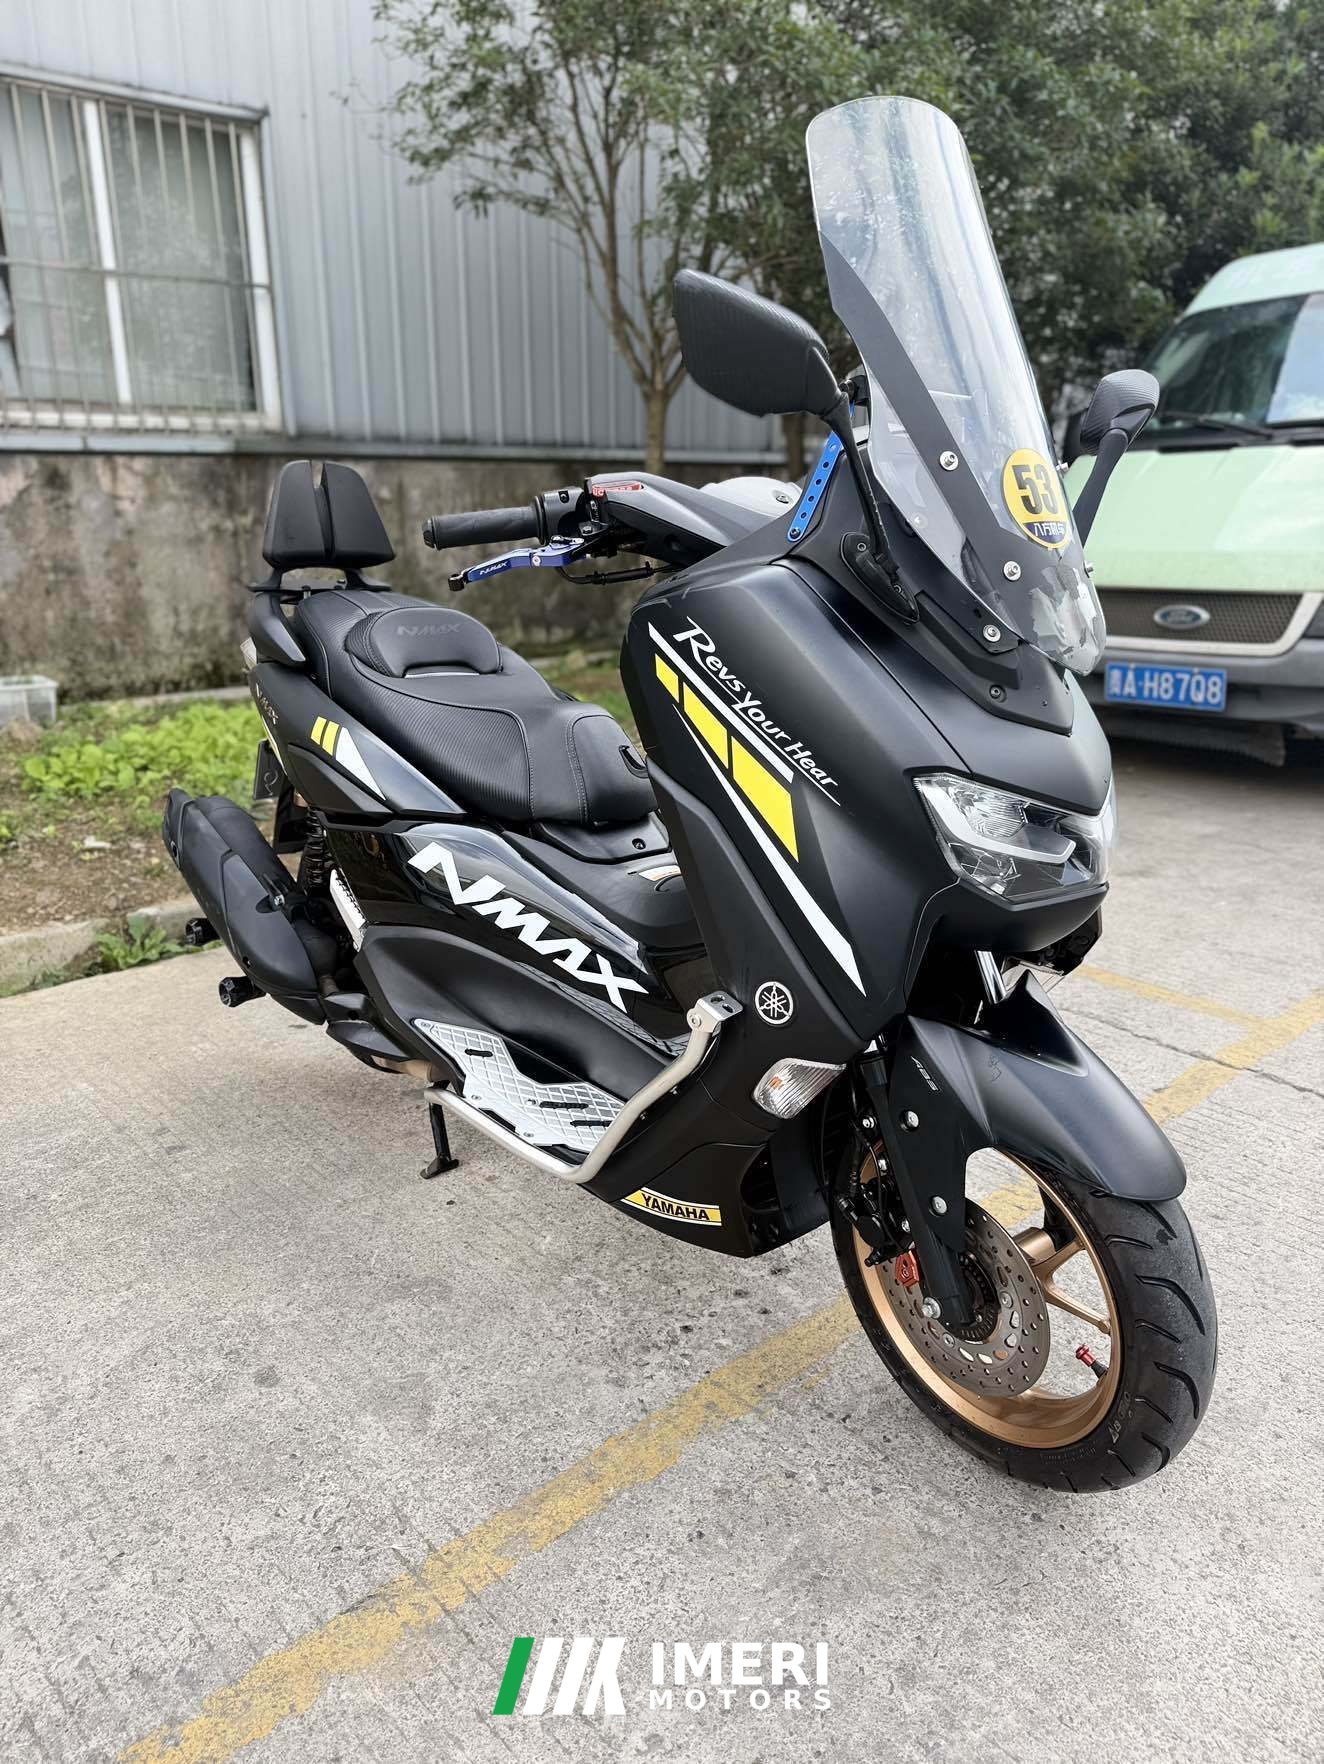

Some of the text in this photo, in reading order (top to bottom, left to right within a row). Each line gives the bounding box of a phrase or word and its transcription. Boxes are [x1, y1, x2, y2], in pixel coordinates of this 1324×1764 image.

[1012, 464, 1058, 514] 53
[397, 623, 460, 637] NMAX
[673, 616, 838, 787] Revs Your Hear
[407, 841, 650, 1014] NMAX
[910, 1055, 939, 1091] ABS
[641, 1193, 710, 1221] YAMAHA
